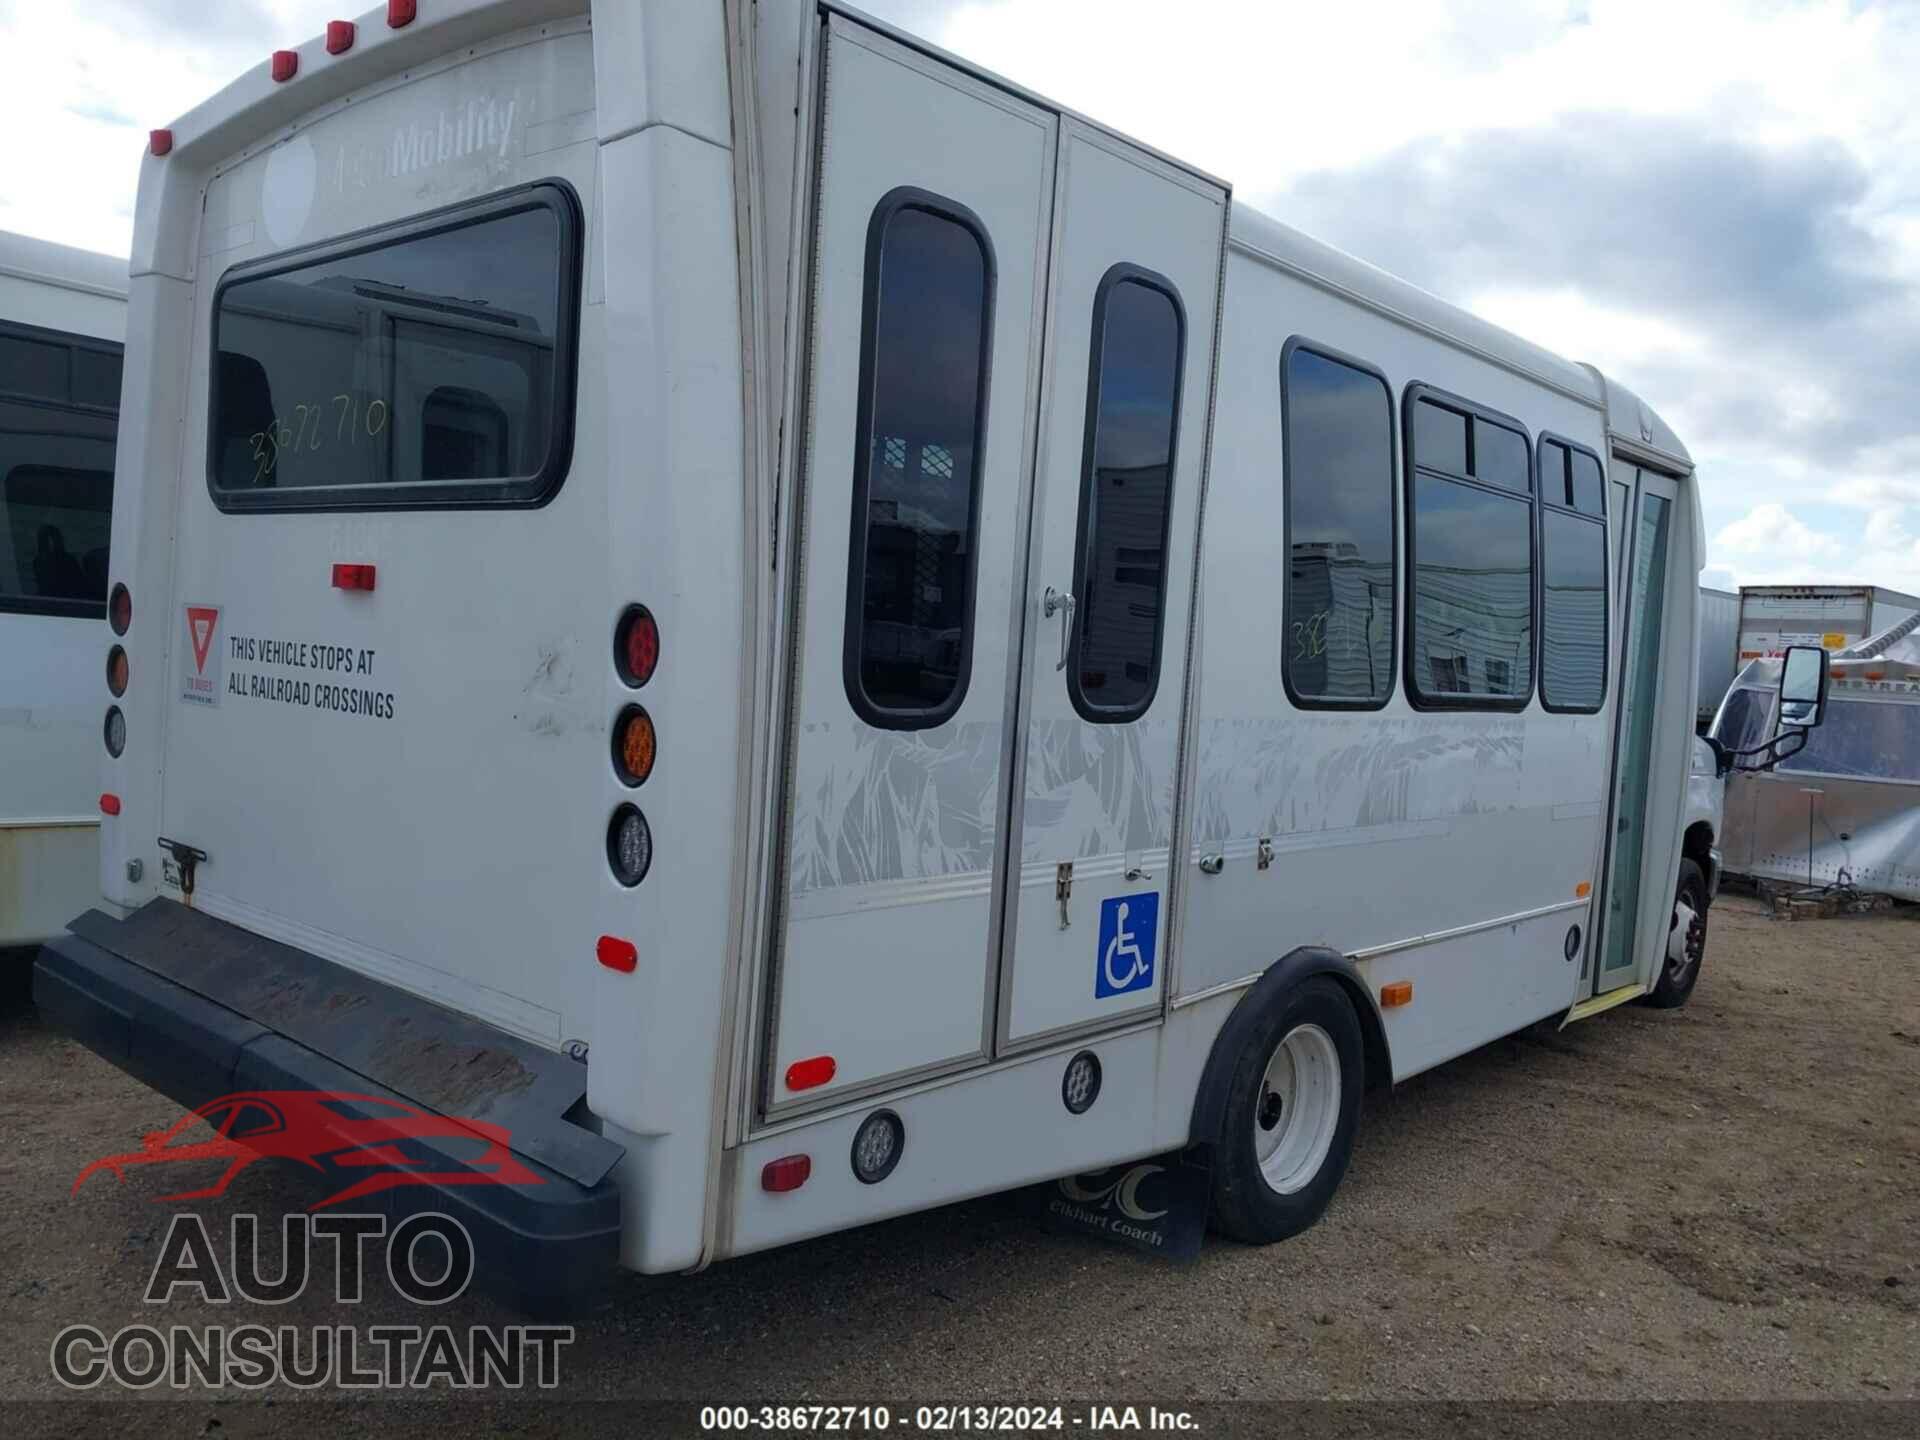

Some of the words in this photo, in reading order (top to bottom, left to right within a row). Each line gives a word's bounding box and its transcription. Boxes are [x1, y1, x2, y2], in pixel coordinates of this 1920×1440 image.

[230, 636, 255, 661] THIS
[259, 639, 306, 668] VEHICLE
[311, 644, 353, 673] STOPS
[357, 649, 375, 675] AT
[228, 672, 248, 697] ALL
[251, 675, 310, 706] RAILROAD
[314, 684, 394, 720] CROSSINGS
[1111, 1219, 1164, 1247] Coach
